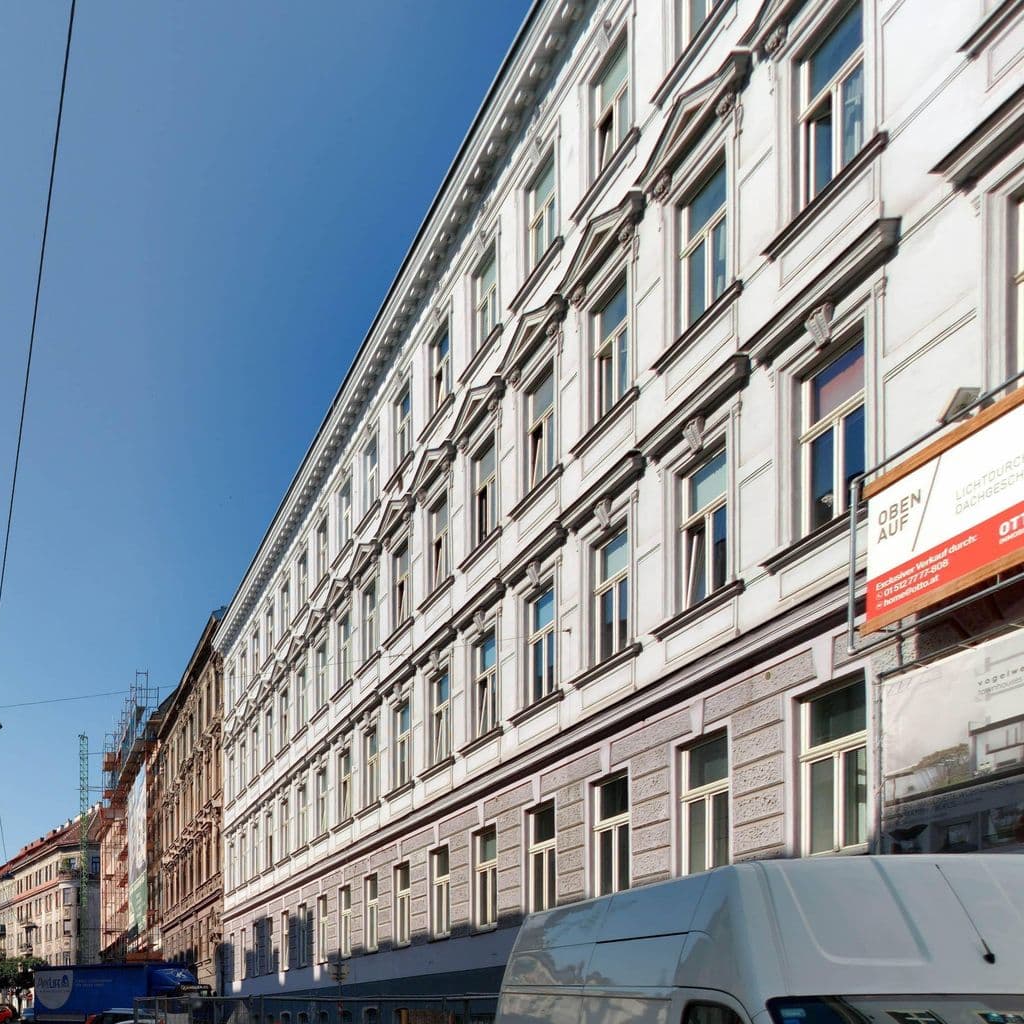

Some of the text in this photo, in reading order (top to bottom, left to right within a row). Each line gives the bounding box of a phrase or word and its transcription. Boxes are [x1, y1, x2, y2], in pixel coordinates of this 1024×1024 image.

[878, 488, 921, 525] OBEN
[877, 513, 909, 544] AUF
[915, 547, 948, 570] Verkauf
[948, 534, 977, 554] durch:
